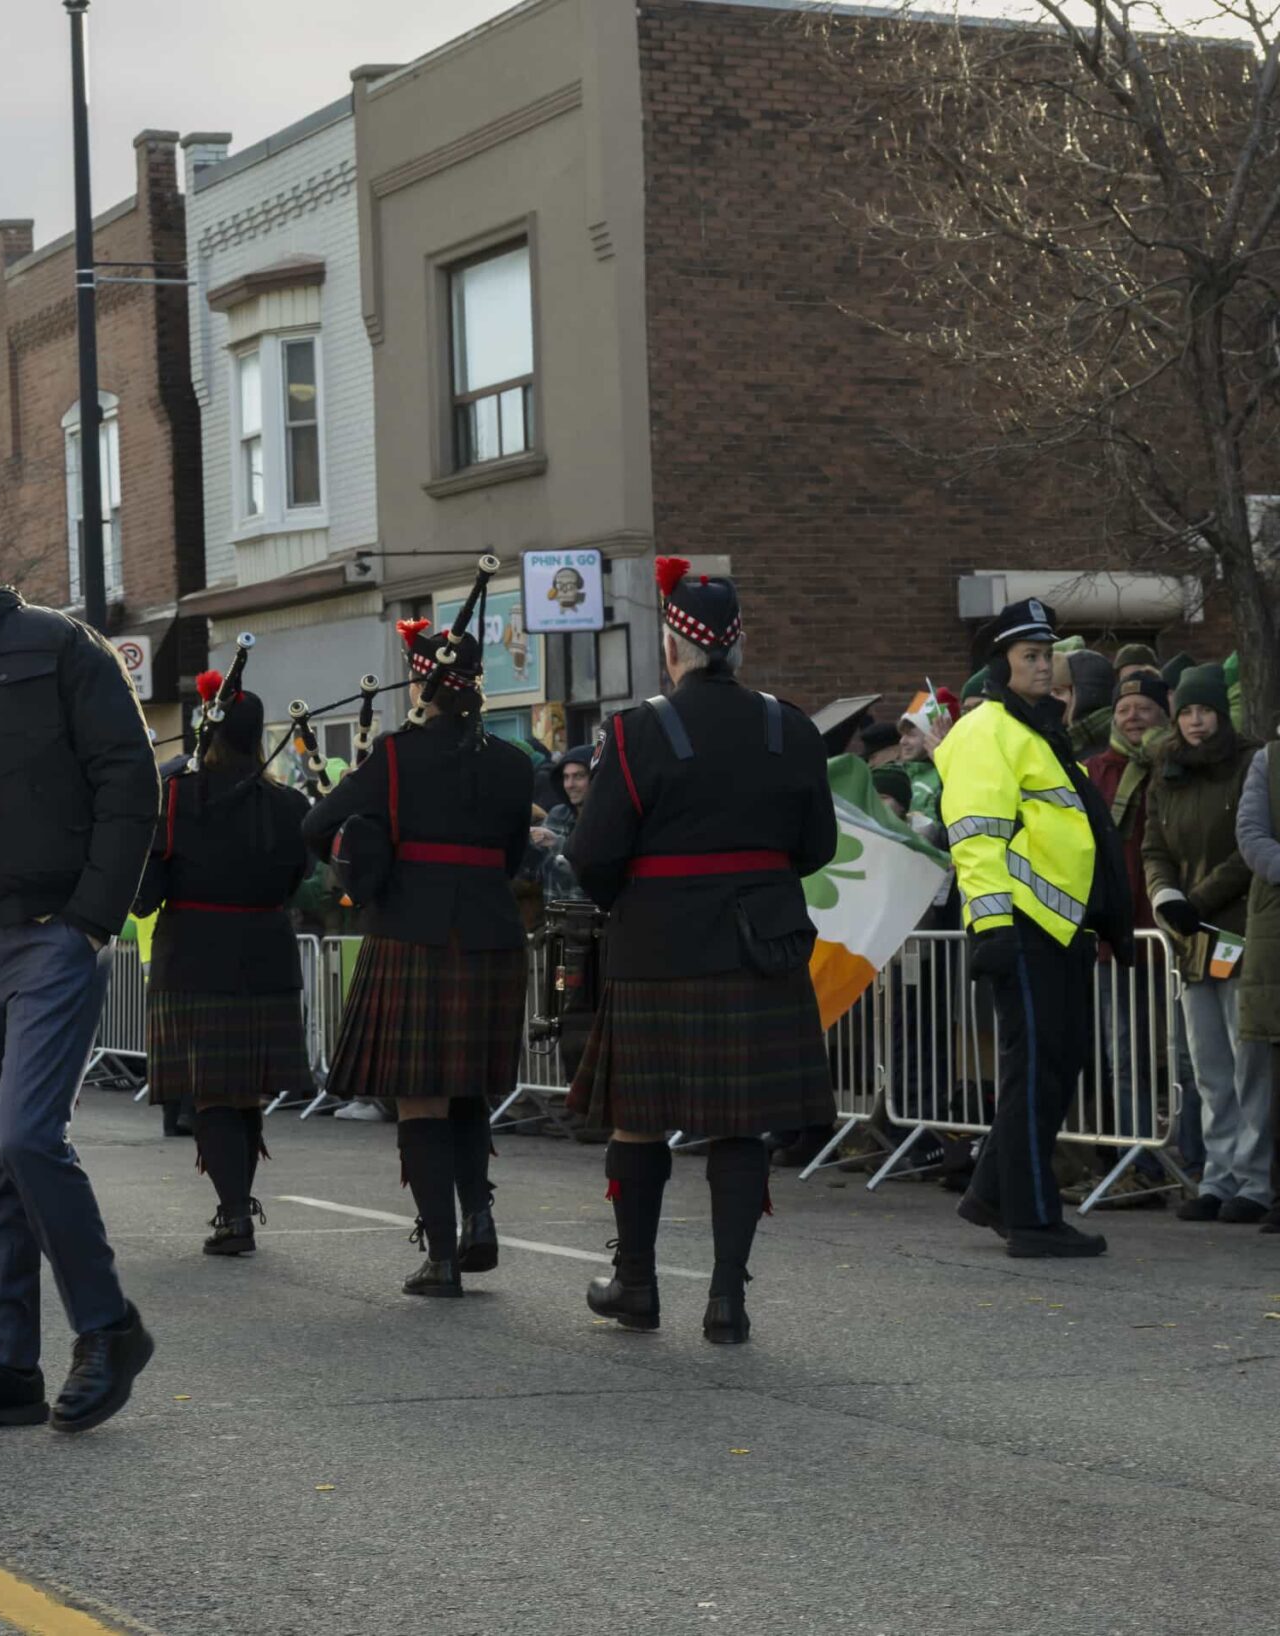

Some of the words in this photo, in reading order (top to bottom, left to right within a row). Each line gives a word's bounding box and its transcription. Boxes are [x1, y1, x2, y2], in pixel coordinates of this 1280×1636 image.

[531, 555, 560, 567] PHIN
[564, 554, 574, 566] &
[576, 553, 596, 566] GO
